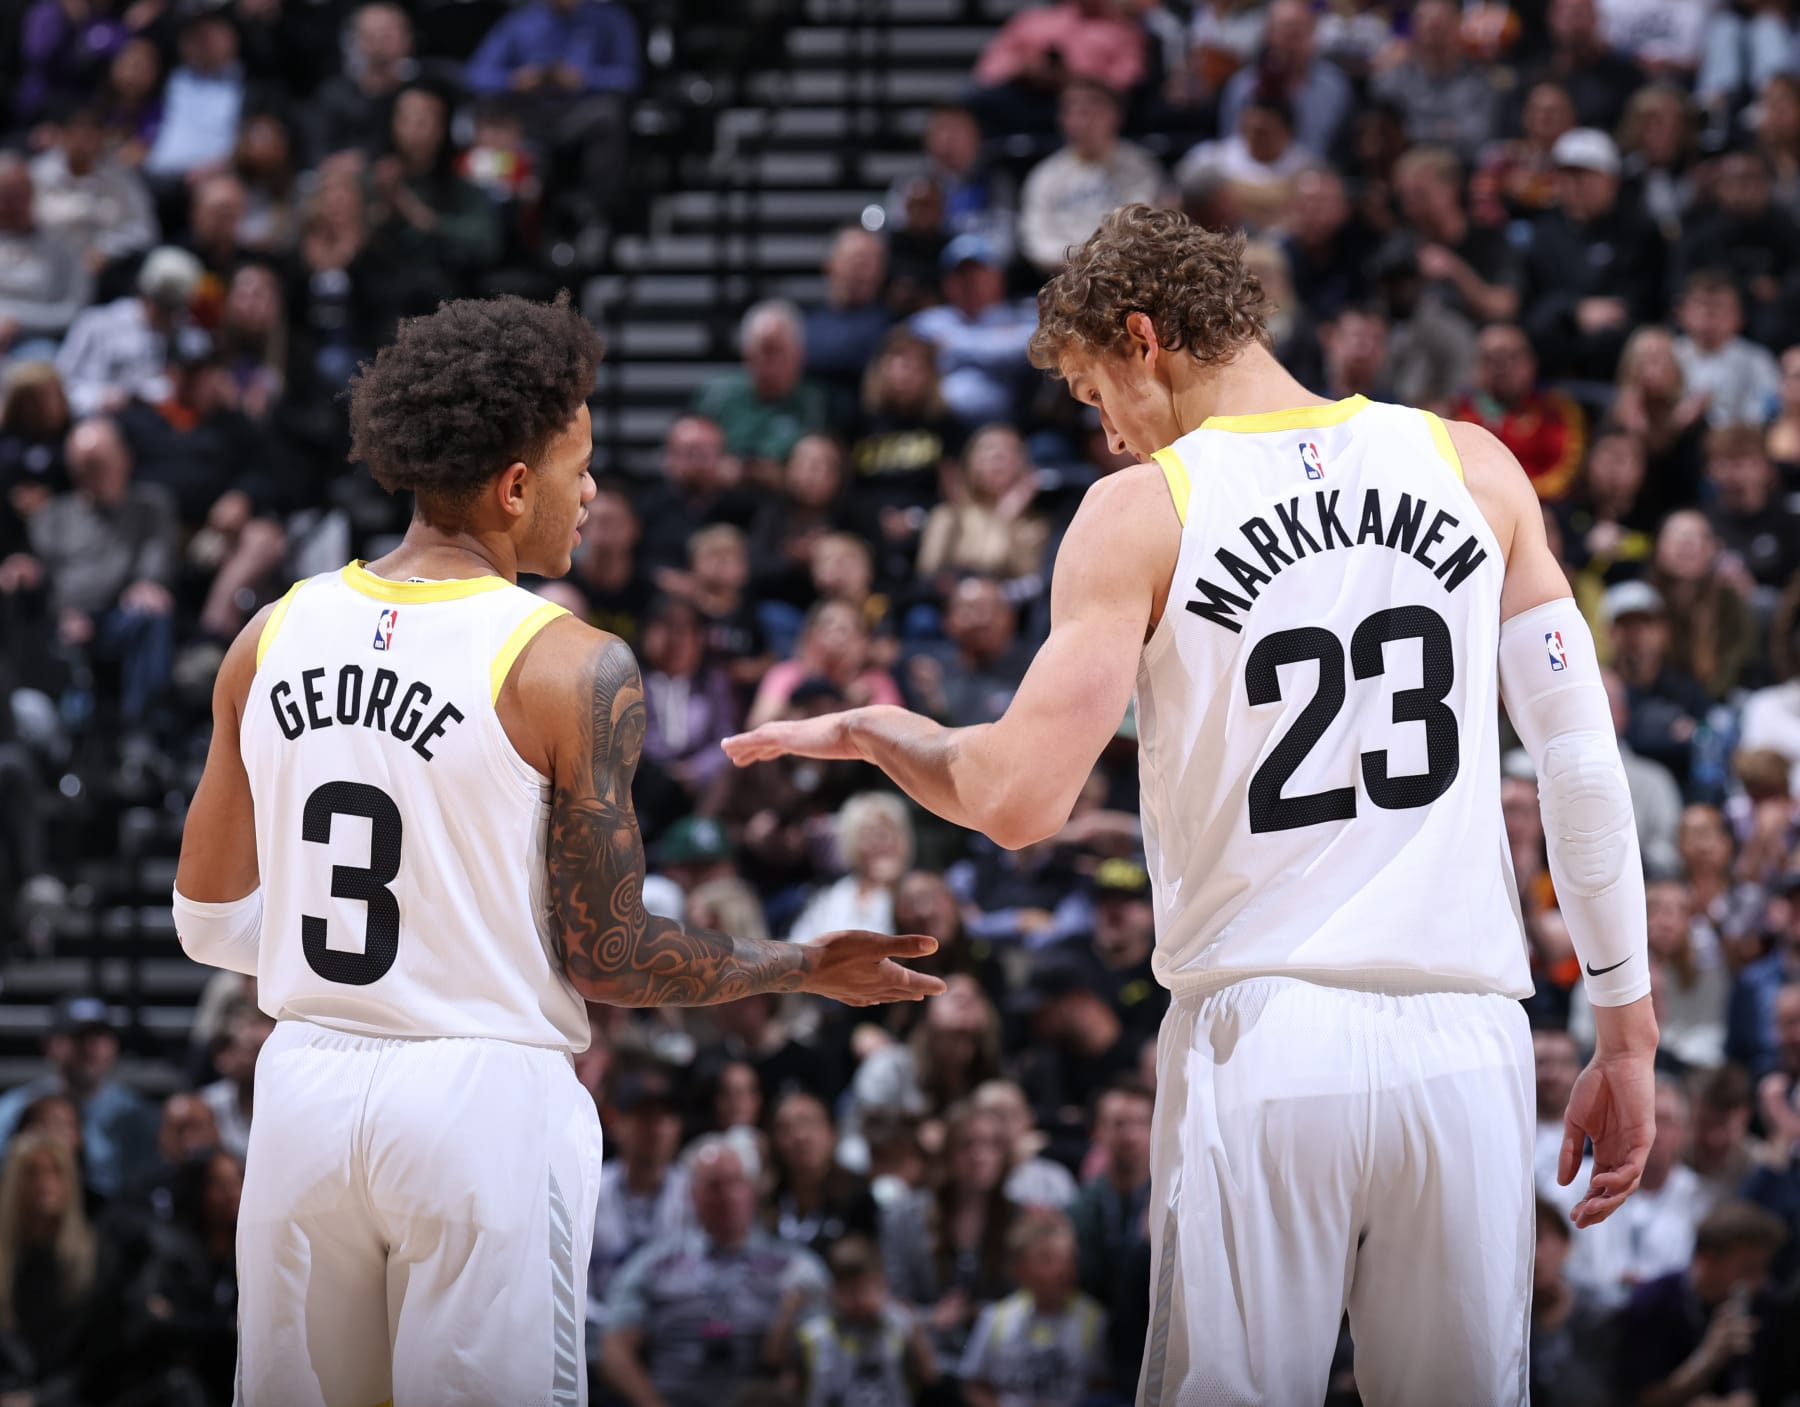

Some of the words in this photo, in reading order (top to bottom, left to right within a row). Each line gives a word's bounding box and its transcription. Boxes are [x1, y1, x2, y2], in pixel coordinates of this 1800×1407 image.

[1185, 488, 1487, 634] MARKKANEN
[270, 664, 465, 762] GEORGE
[1245, 605, 1460, 835] 23
[301, 780, 403, 986] 3
